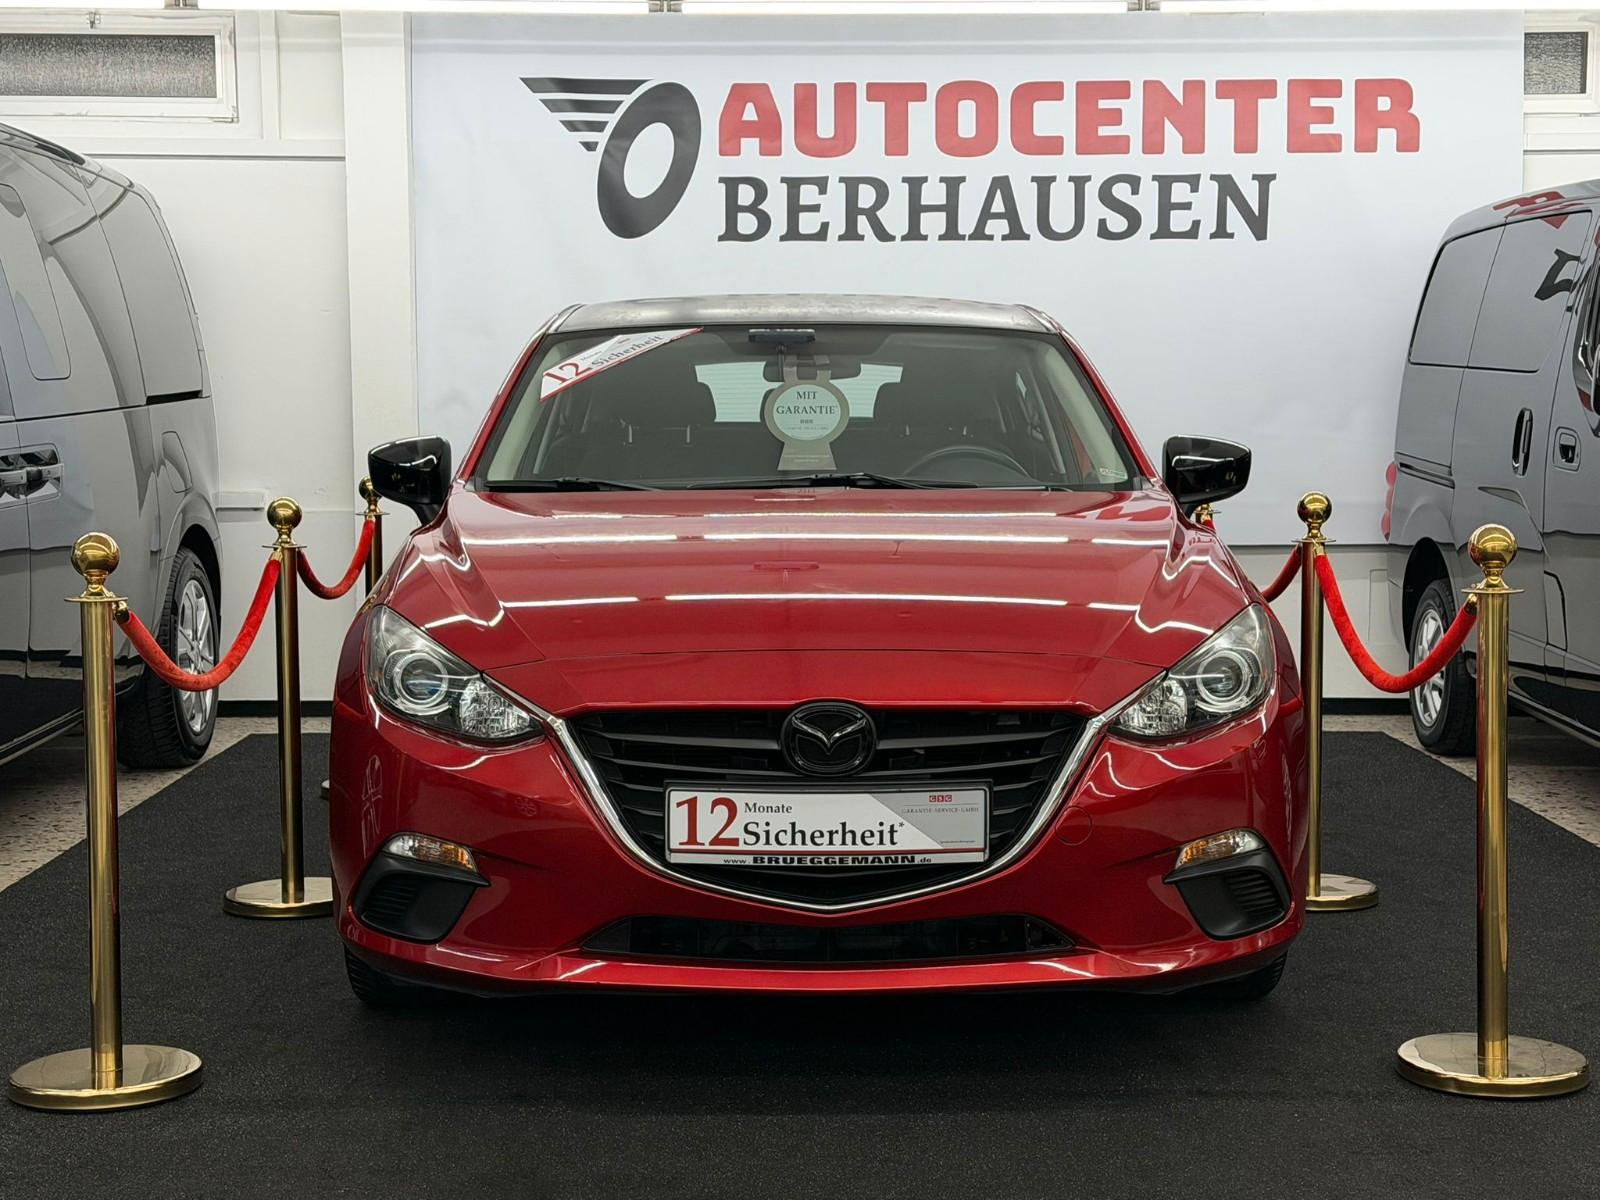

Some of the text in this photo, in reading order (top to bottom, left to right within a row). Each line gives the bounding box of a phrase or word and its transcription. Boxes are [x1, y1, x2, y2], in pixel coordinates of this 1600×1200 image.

[718, 78, 1421, 158] AUTOCENTER
[717, 173, 1277, 242] BERHAUSEN
[591, 334, 664, 367] Sicherheit
[544, 362, 592, 384] 12
[796, 390, 818, 400] MIT
[776, 405, 838, 415] GARANTIE
[675, 795, 740, 847] 12
[744, 801, 793, 814] Monate
